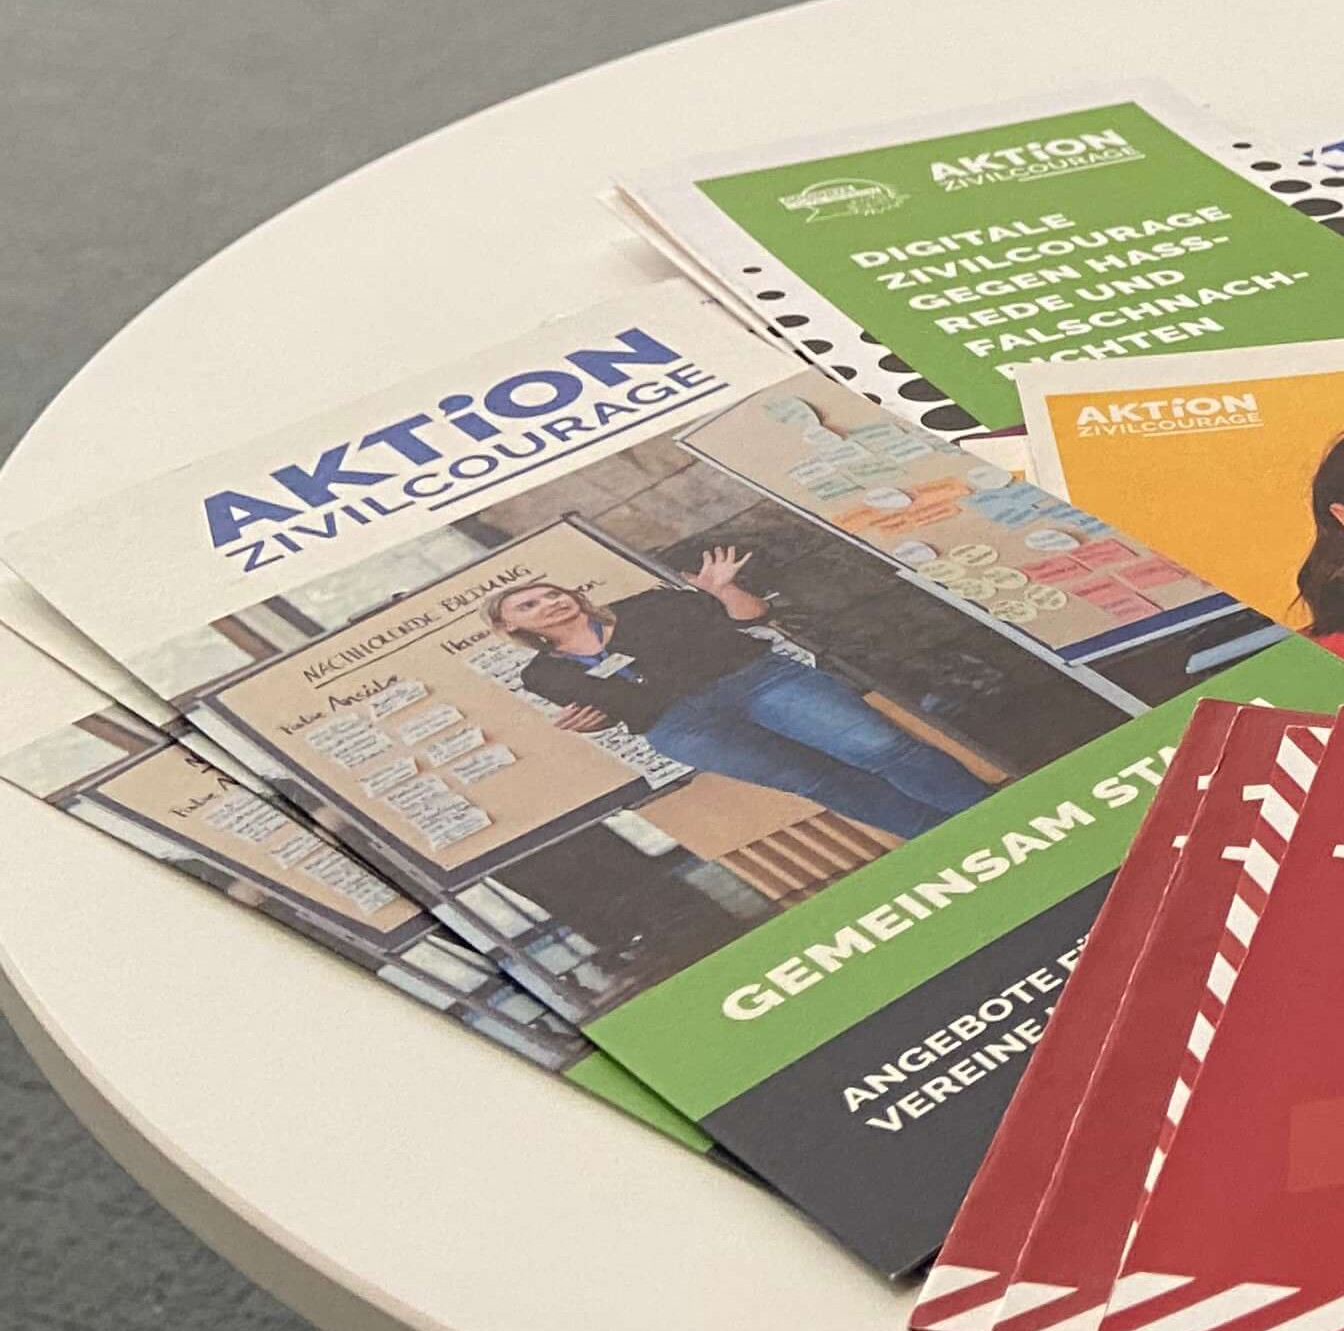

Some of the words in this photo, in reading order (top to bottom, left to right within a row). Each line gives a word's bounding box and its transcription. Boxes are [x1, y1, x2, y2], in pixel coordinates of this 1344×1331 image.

[943, 144, 1144, 193] ZIVILCOURAGE
[850, 213, 1076, 268] DIGITALE
[877, 205, 1231, 291] ZIVILCOURAGE
[908, 258, 1076, 311] GEGEN
[1083, 233, 1230, 275] HASS-
[933, 293, 1074, 336] REDE
[1082, 270, 1185, 302] UND
[963, 271, 1310, 358] FALSCHNACH-
[995, 318, 1224, 379] RCHTEN
[1078, 412, 1263, 437] ZIVILCOURAGE
[227, 363, 716, 573] ZIVILCOURAGE
[722, 801, 1097, 1021] GEMEINSAM
[842, 967, 1063, 1113] ANGEBOTE
[866, 1018, 1043, 1134] VEREINE
